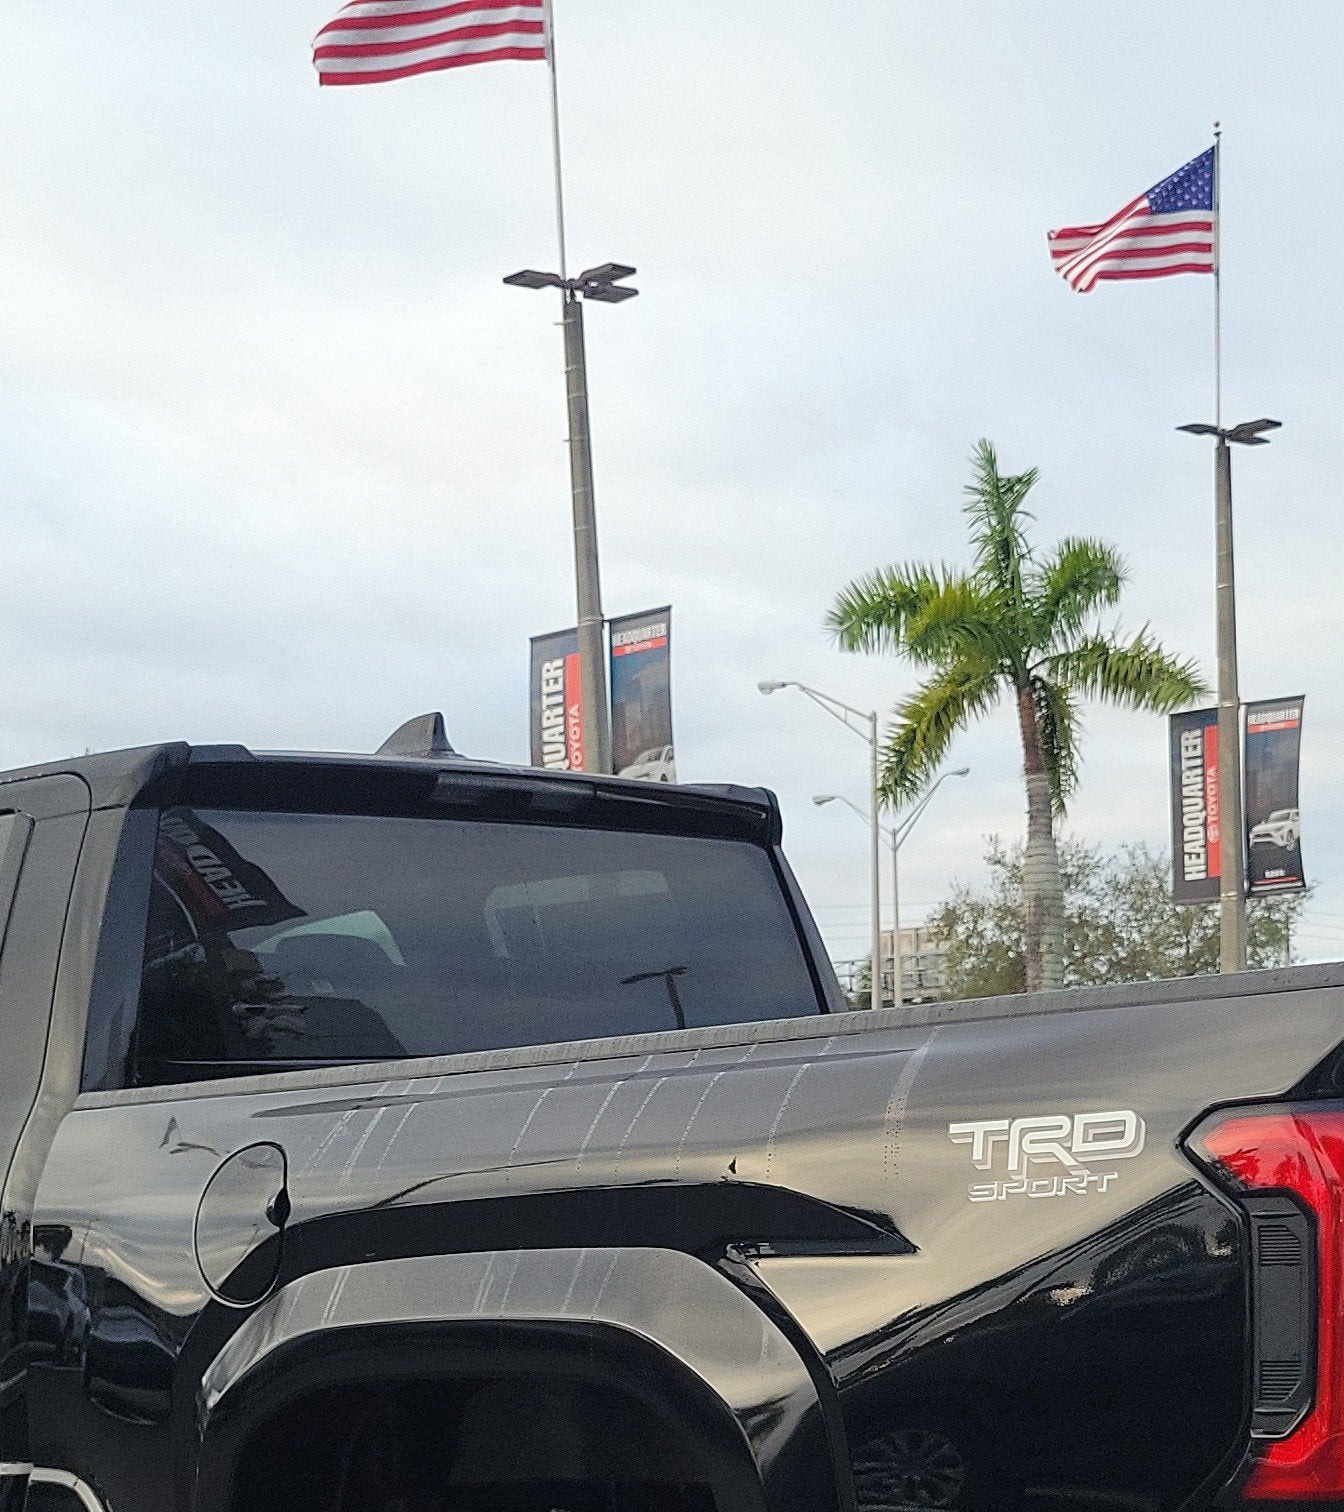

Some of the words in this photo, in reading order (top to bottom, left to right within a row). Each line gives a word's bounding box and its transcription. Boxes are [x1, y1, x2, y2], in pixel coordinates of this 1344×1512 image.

[1181, 729, 1207, 881] HEADQUARTER
[948, 1110, 1147, 1180] TRD
[967, 1171, 1119, 1203] SPORT
